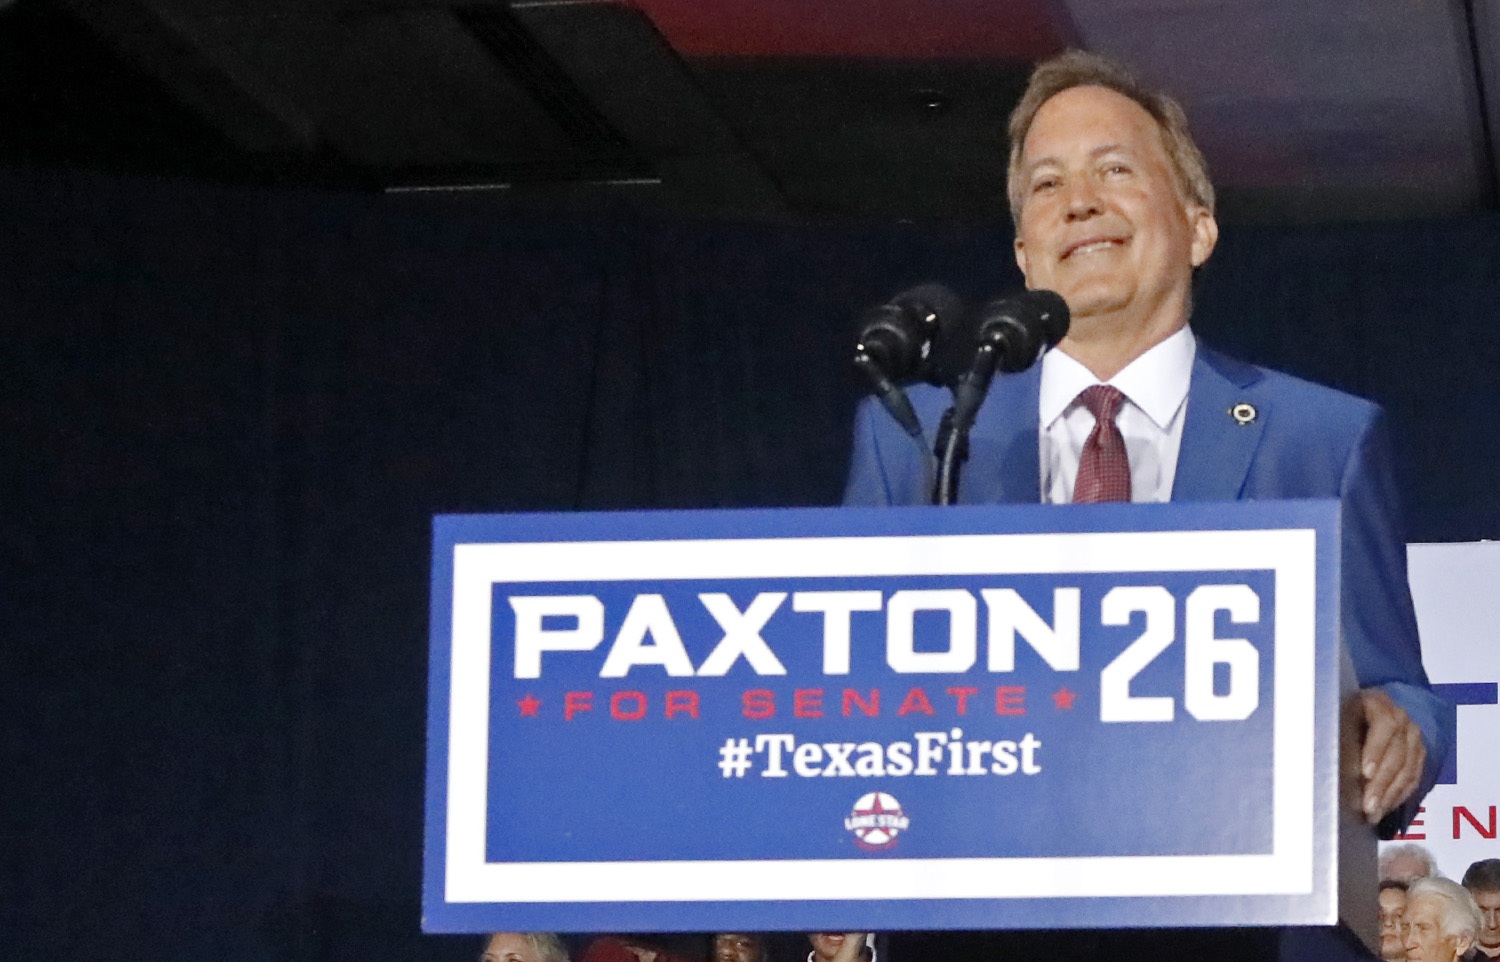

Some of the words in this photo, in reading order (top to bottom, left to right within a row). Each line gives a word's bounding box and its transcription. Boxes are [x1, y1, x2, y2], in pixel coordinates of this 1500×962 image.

[509, 588, 1081, 678] PAXTON
[1100, 585, 1260, 723] 26
[563, 691, 700, 721] FOR
[741, 686, 1027, 718] SENATE
[718, 728, 1041, 778] #TexasFirst
